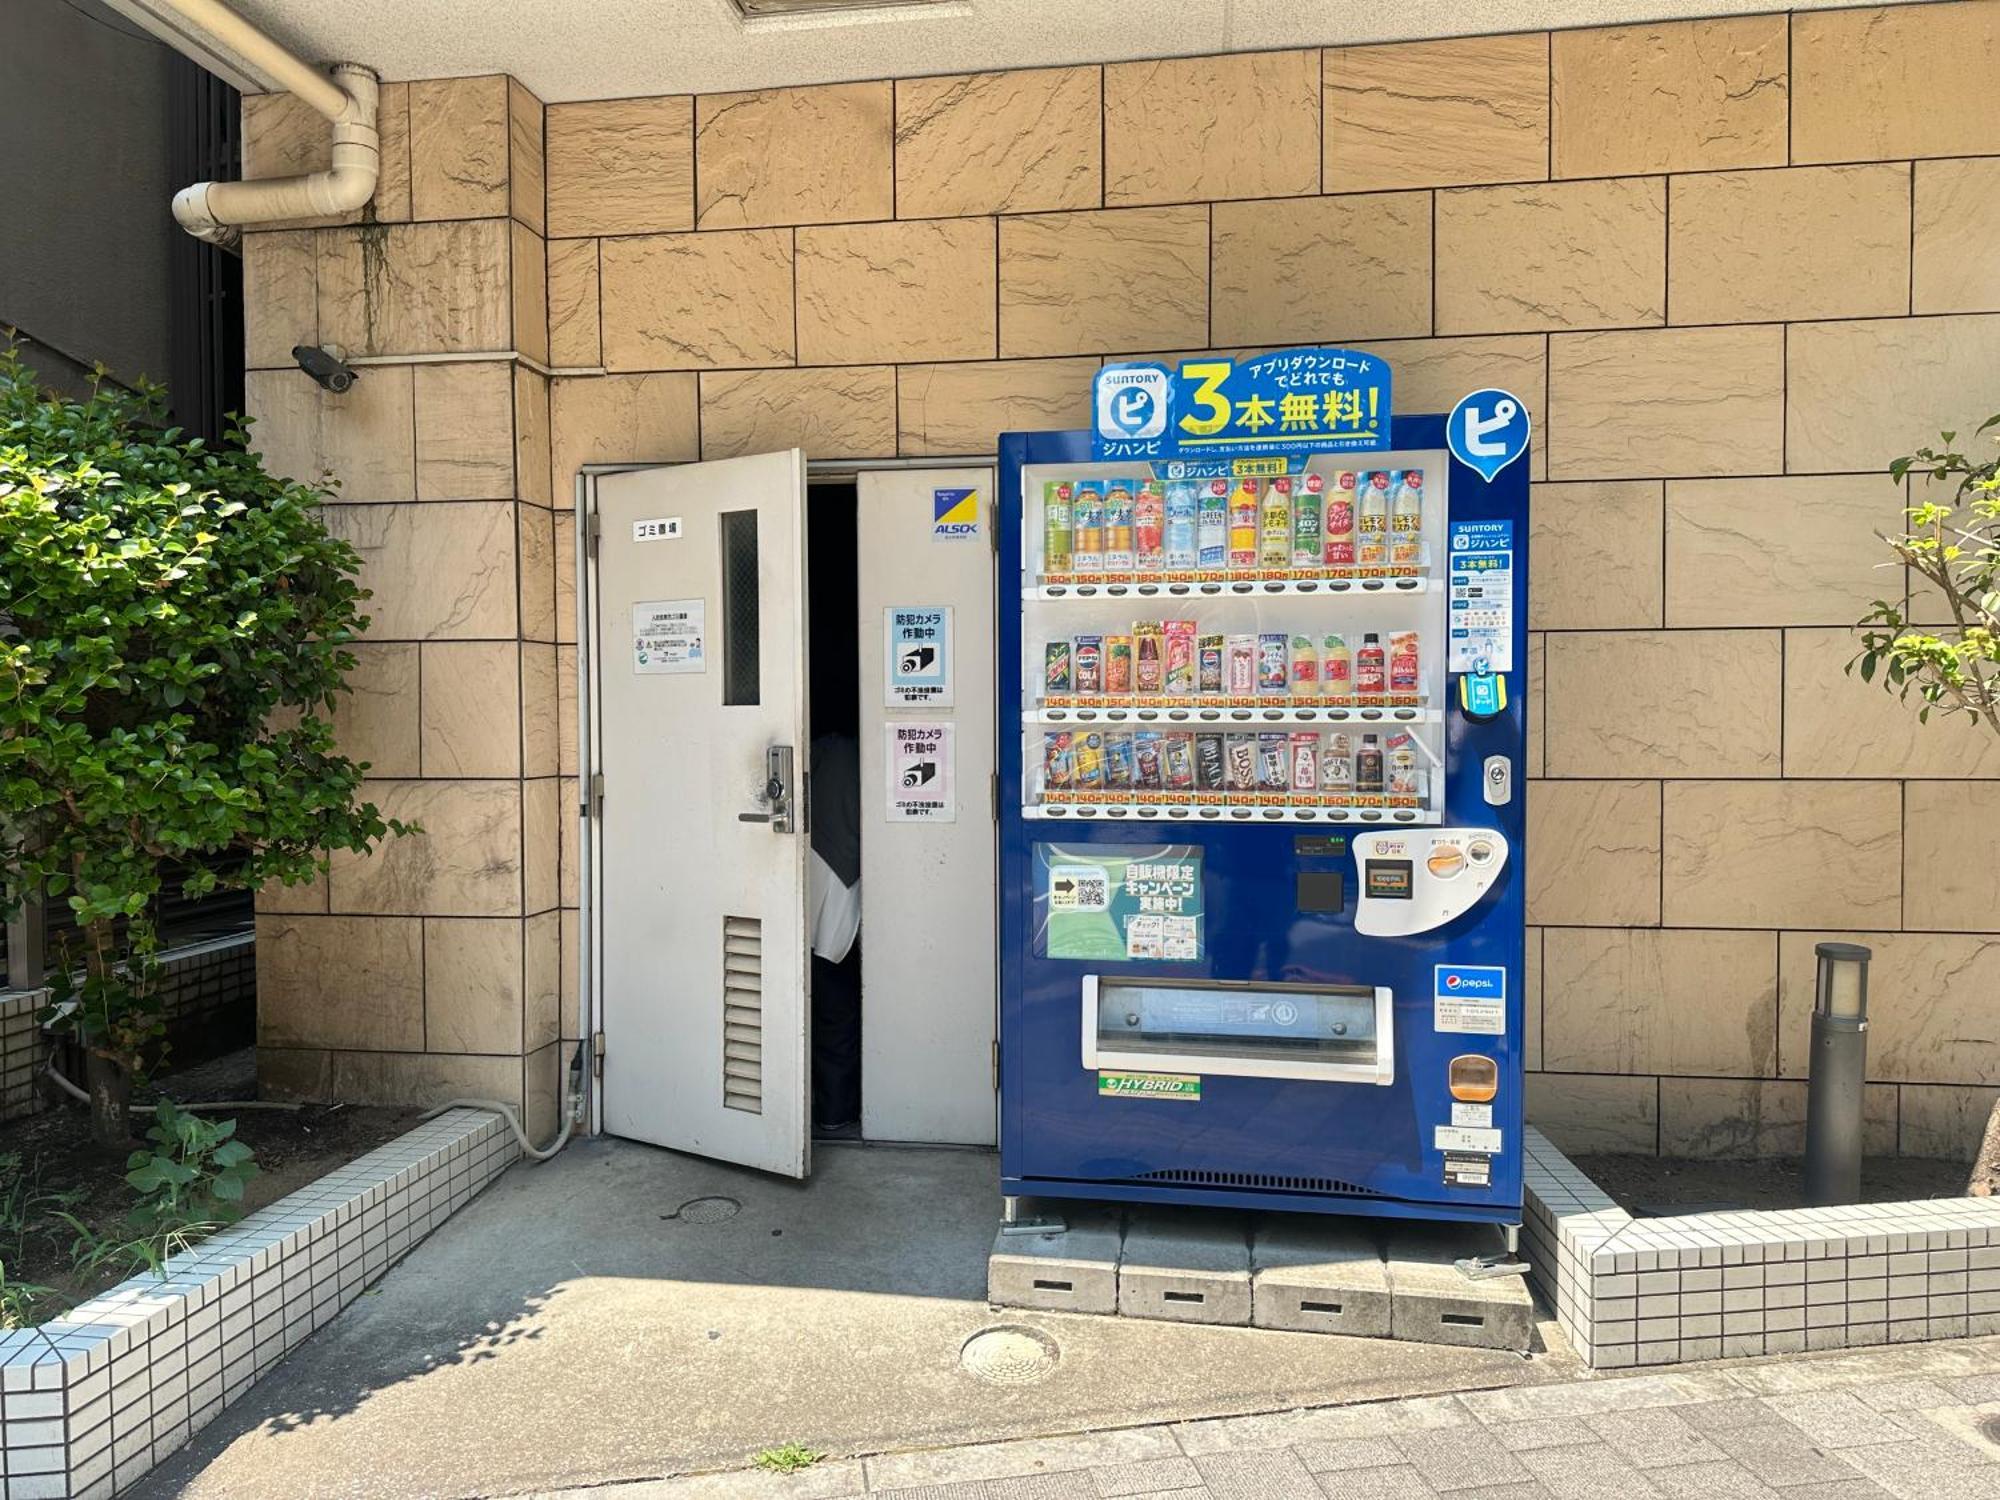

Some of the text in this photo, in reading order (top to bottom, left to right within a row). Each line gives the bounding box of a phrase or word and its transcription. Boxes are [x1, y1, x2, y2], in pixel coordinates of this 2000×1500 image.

[1249, 355, 1372, 379] アプリダウンロード
[1106, 375, 1159, 386] SUNTORY
[1274, 372, 1345, 388] でどれでも
[1179, 362, 1379, 437] 3本無料!
[1465, 399, 1517, 457] ピ
[1103, 440, 1162, 456] ジハンピ
[1187, 464, 1229, 477] ジハンピ
[935, 524, 977, 534] ALSOK
[1458, 524, 1504, 533] SUNTORY
[1470, 538, 1511, 549] ジハンピ
[896, 614, 941, 625] 防犯カメラ
[903, 627, 935, 639] 作動中
[1078, 670, 1097, 680] COLA
[897, 729, 942, 741] 防犯カメラ
[904, 742, 937, 754] 作動中
[1236, 747, 1253, 788] BOSS
[1126, 864, 1194, 880] 自販機限定
[1125, 880, 1194, 897] キャンペーン
[1462, 979, 1491, 989] pepsi
[1116, 1078, 1183, 1093] HYBRID
